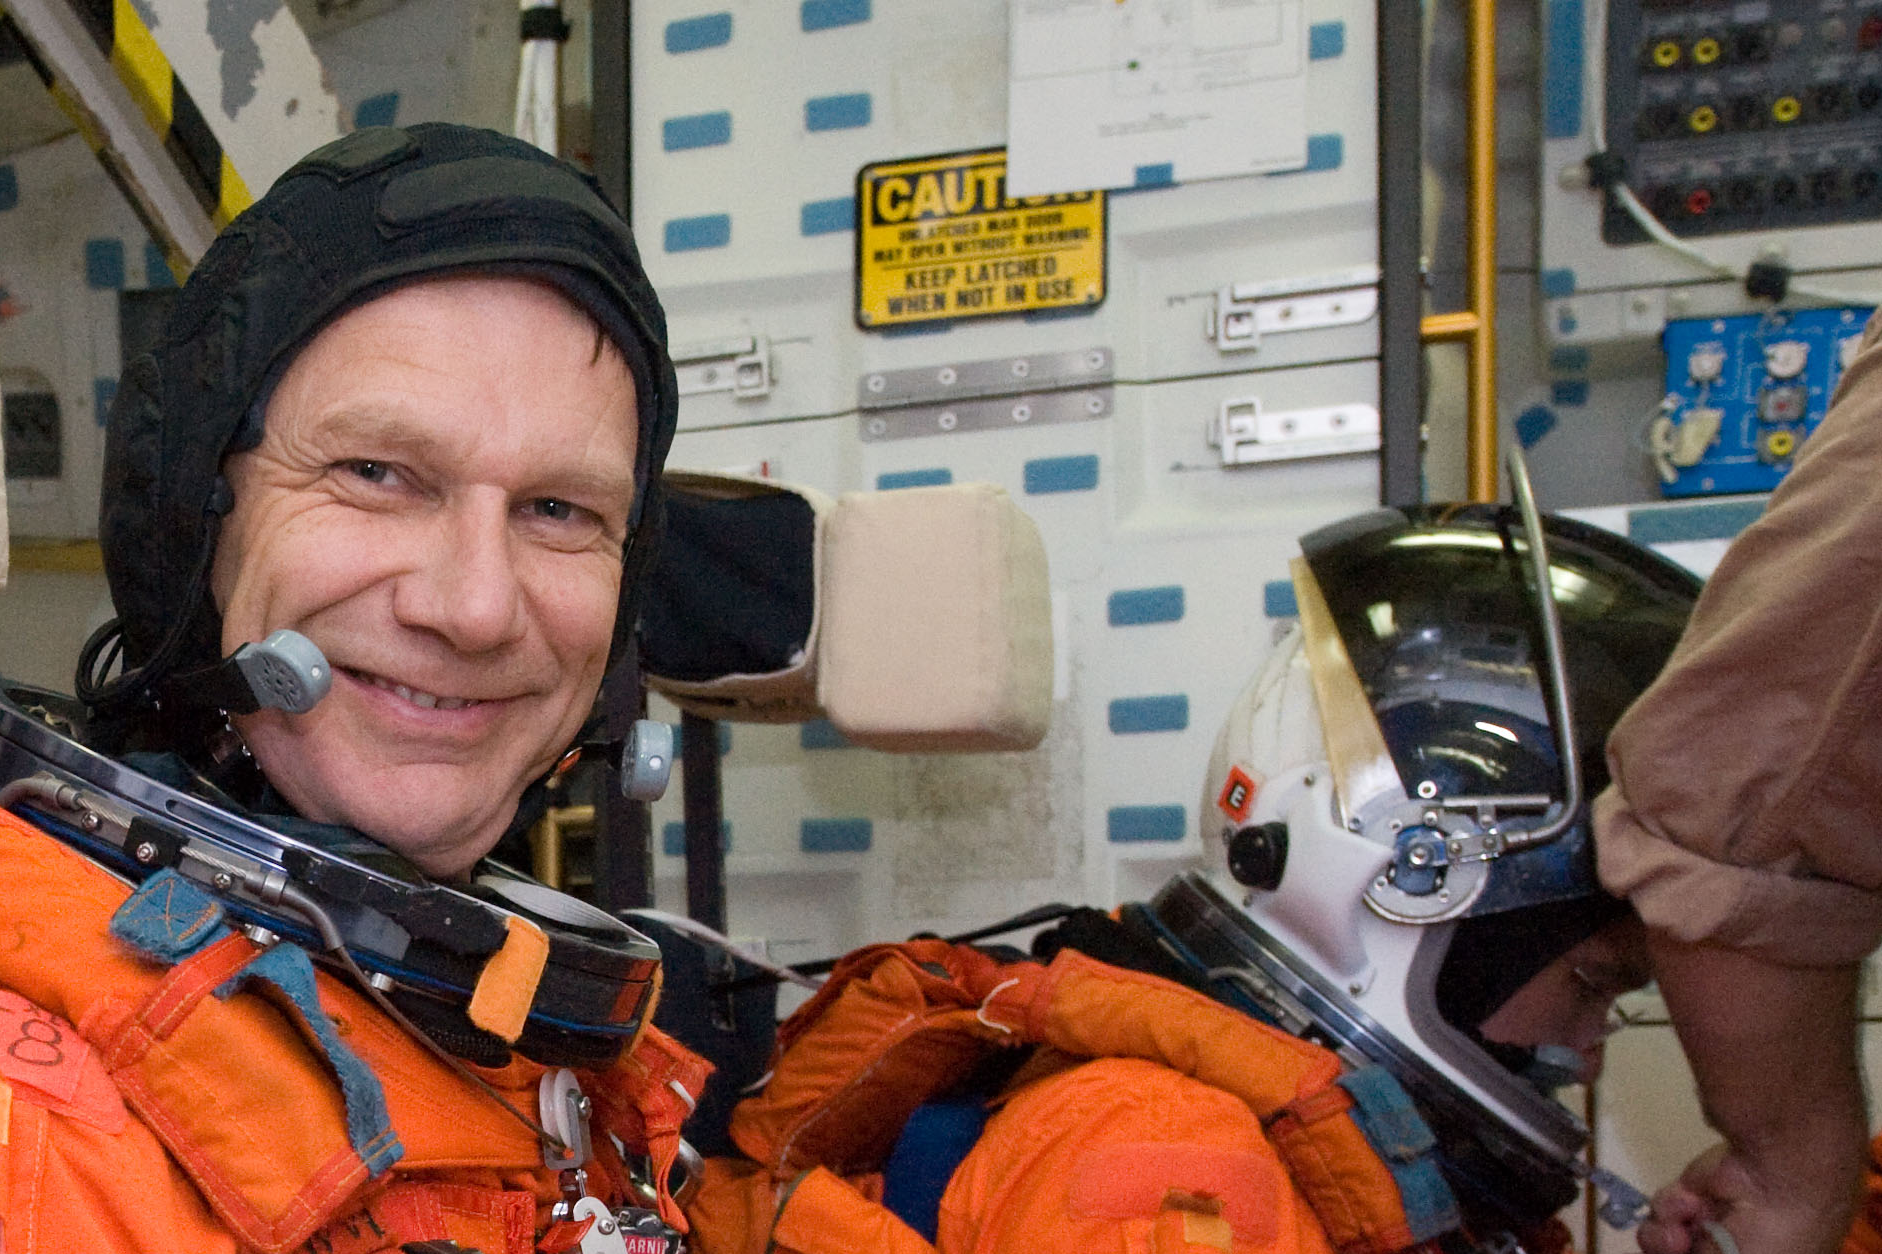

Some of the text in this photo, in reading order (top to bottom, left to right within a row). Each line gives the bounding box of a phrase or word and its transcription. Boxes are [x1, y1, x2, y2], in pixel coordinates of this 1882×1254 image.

[877, 165, 1093, 222] CAUT
[910, 242, 945, 258] OPEN
[953, 235, 1016, 252] WITHOUT
[1024, 227, 1091, 245] WARNING
[905, 256, 1057, 290] KEEP LATCHED
[888, 278, 1074, 316] WHEN NOT IN USE
[1228, 783, 1247, 809] E
